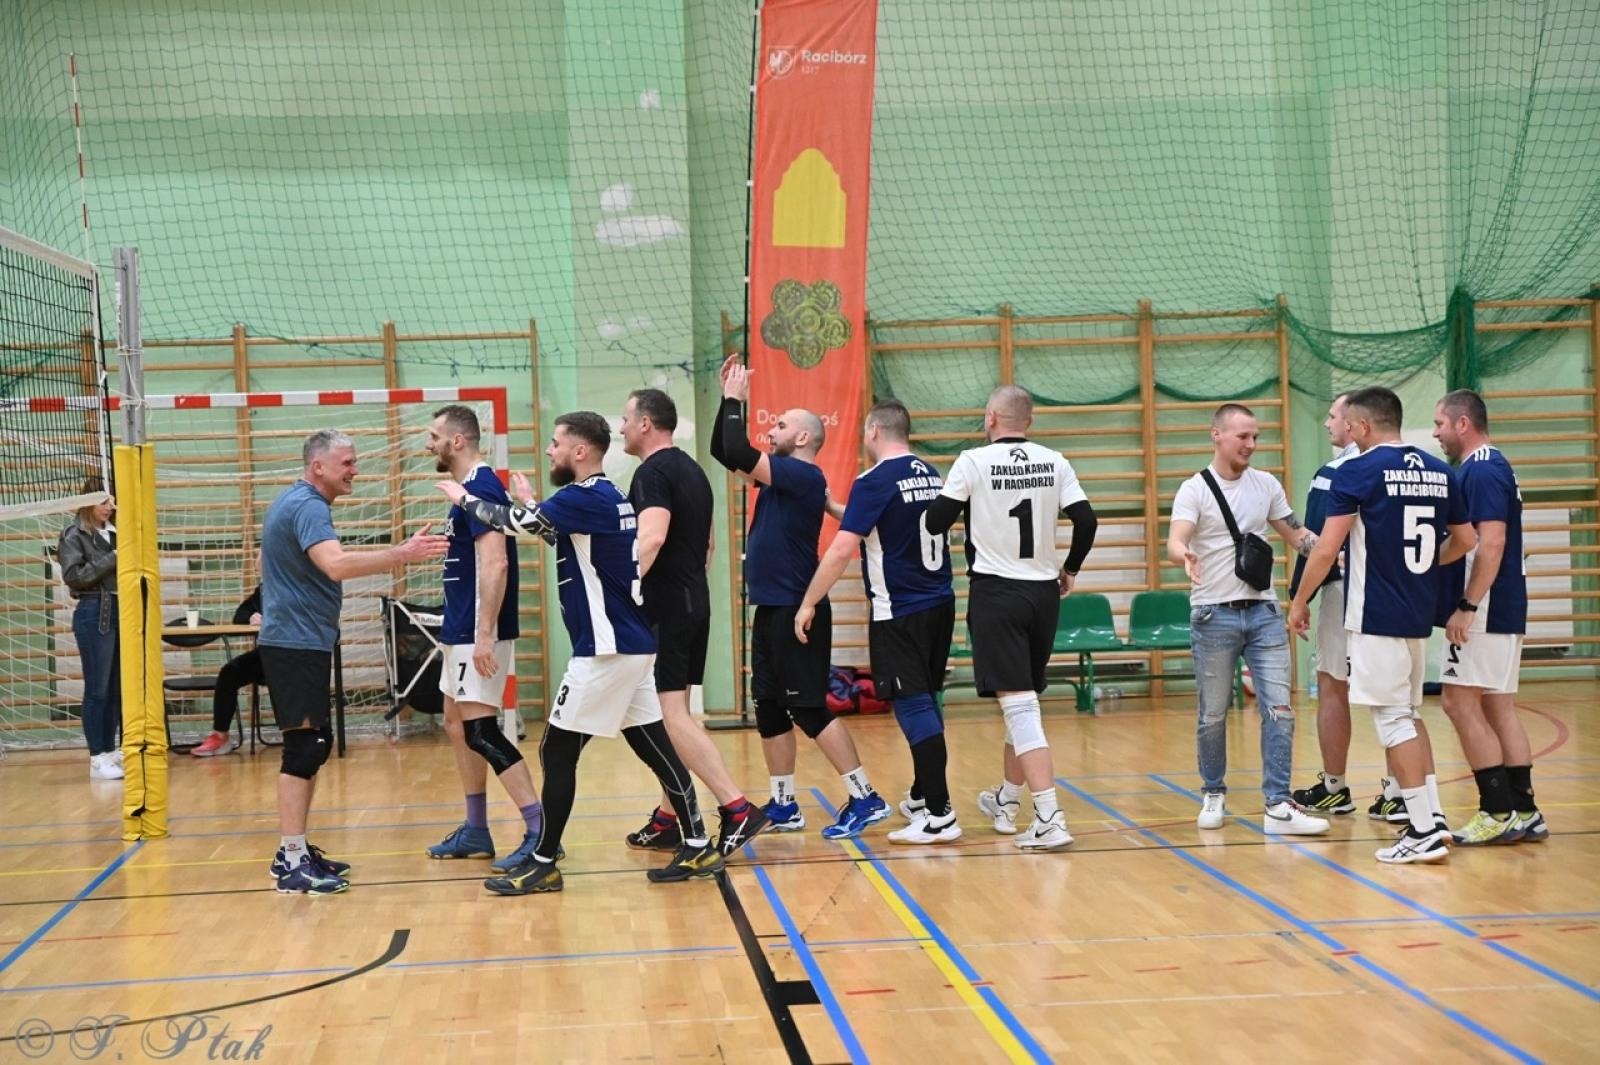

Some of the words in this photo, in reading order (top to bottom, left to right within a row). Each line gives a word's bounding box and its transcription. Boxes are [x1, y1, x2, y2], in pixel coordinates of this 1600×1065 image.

[801, 49, 867, 65] Racibórz
[1024, 462, 1055, 475] KARNY
[1383, 469, 1421, 482] ZAKŁAD
[896, 476, 929, 491] ZAKŁAD
[991, 479, 1002, 490] W
[1386, 483, 1399, 496] W
[1399, 483, 1449, 498] RACIBORZU
[902, 490, 914, 504] W
[1009, 498, 1035, 559] 1
[1403, 505, 1436, 574] 5
[458, 662, 467, 682] 7
[557, 685, 569, 706] 3
